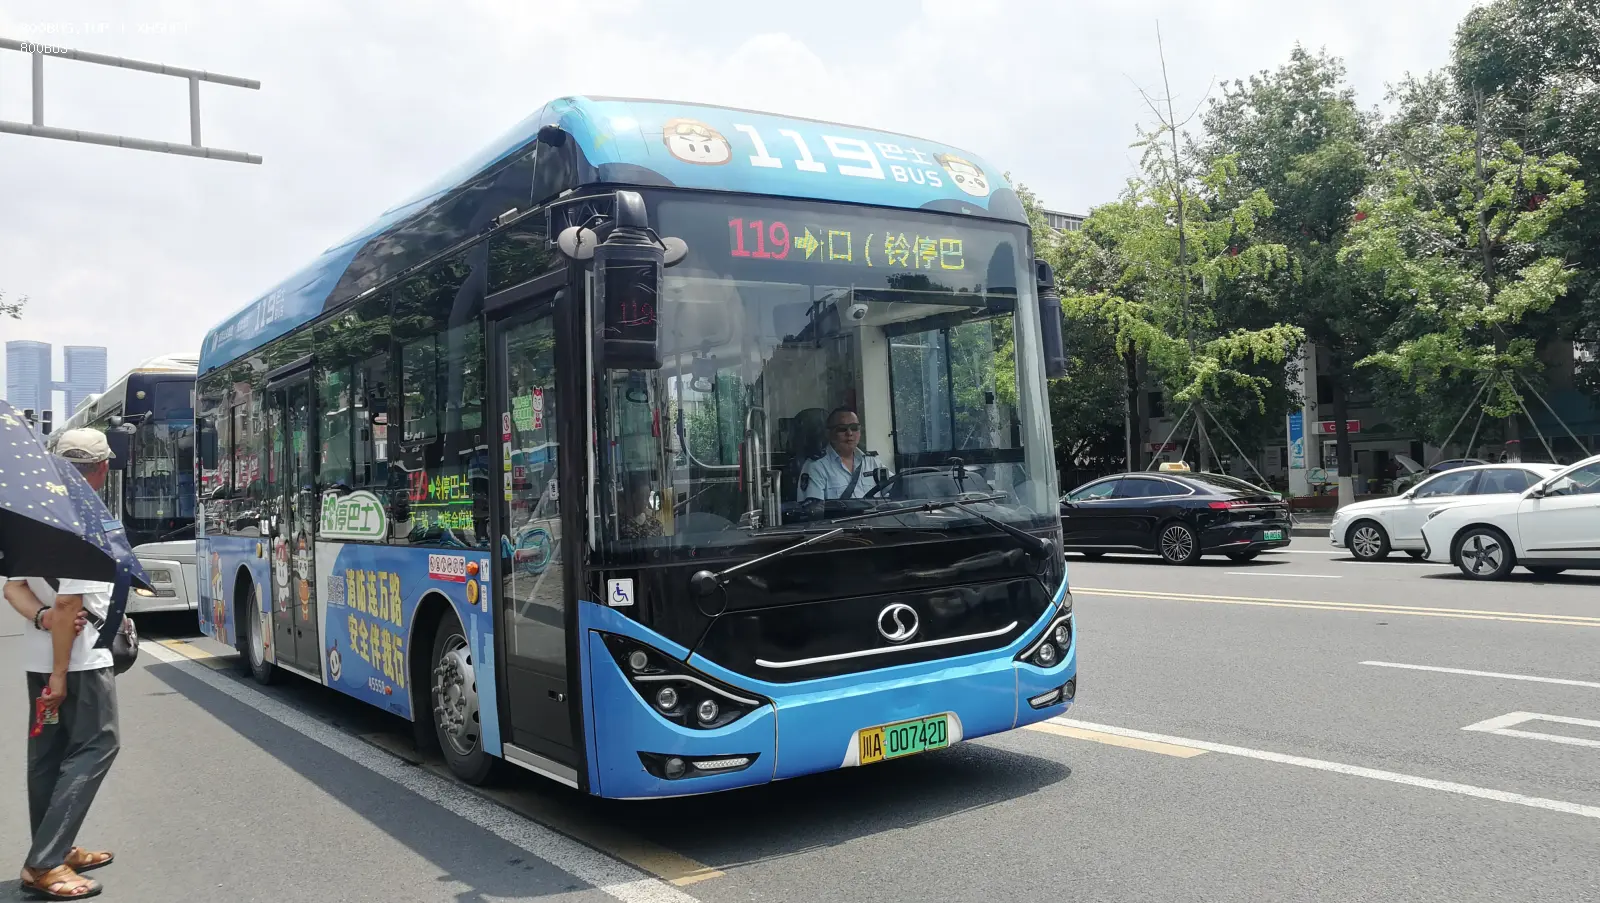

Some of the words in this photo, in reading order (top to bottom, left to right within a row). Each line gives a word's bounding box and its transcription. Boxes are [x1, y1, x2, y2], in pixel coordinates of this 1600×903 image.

[733, 123, 886, 180] 119
[874, 141, 934, 167] 巴士
[891, 166, 943, 188] BUS
[728, 217, 790, 260] 119
[620, 302, 654, 325] 119
[408, 471, 428, 501] 119
[348, 612, 405, 689] 安全伴我行
[863, 733, 882, 759] 川A
[890, 720, 946, 753] 00742D
